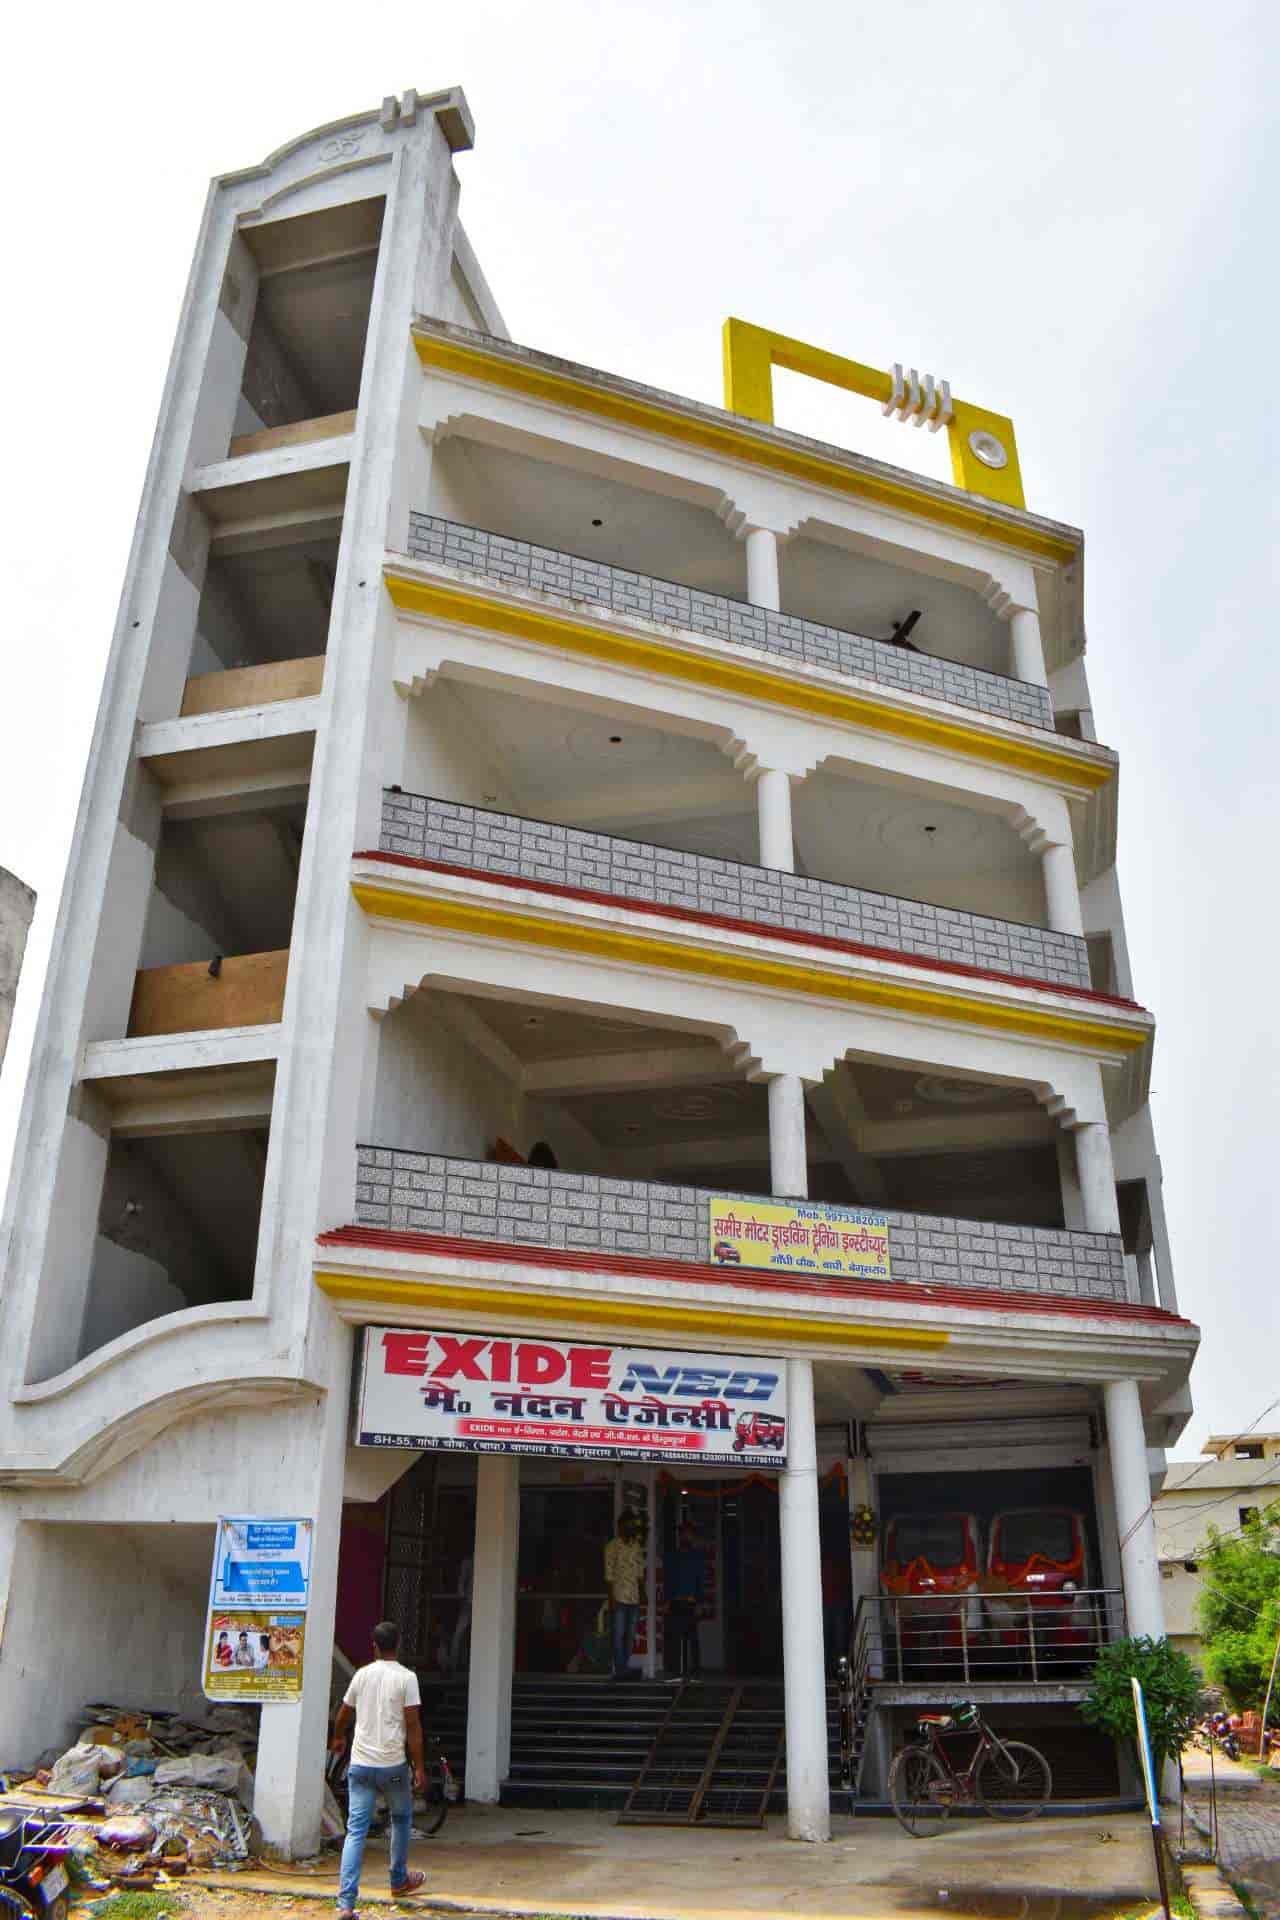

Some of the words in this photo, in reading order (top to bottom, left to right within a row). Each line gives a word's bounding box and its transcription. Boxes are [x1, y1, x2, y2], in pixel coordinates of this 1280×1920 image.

[713, 1212, 741, 1238] समीर
[743, 1216, 769, 1241] मोटर
[797, 1208, 822, 1220] Mob.
[381, 1333, 612, 1390] EXIDE
[619, 1363, 778, 1401] NEO
